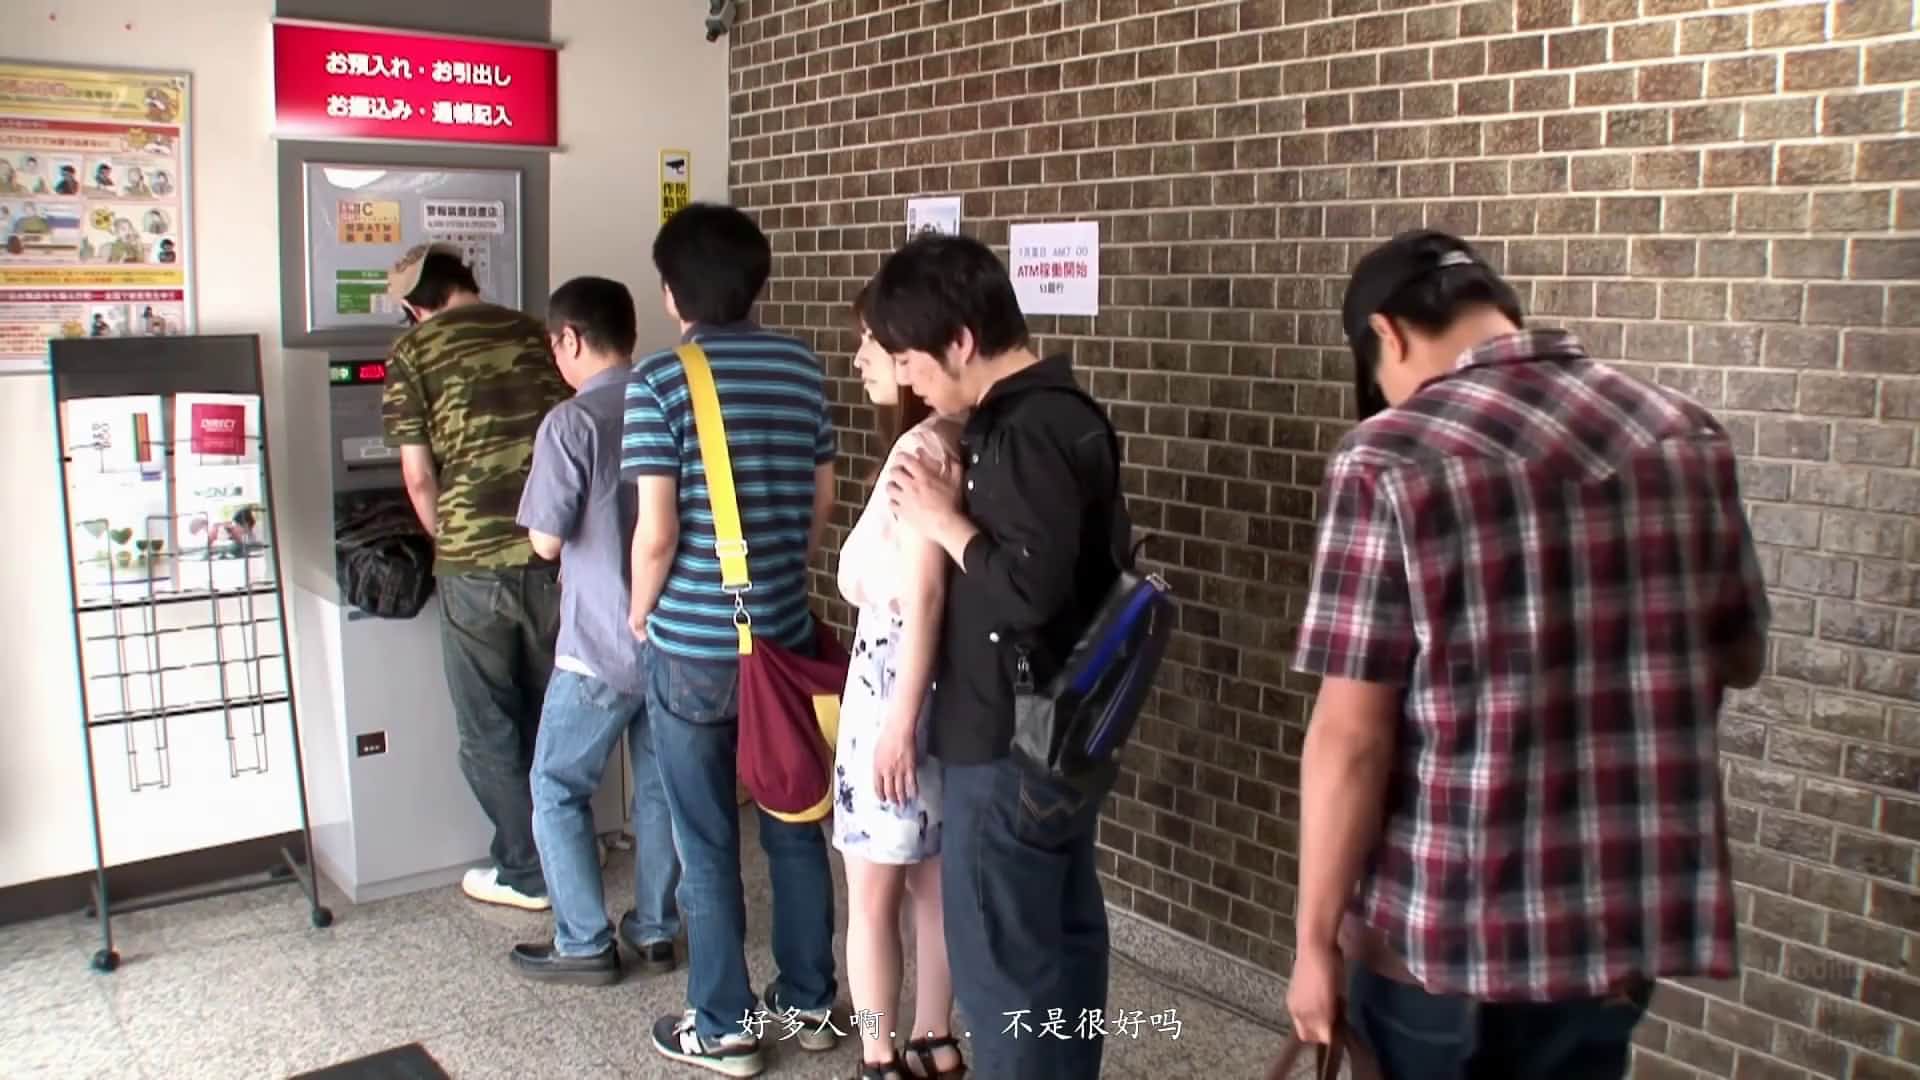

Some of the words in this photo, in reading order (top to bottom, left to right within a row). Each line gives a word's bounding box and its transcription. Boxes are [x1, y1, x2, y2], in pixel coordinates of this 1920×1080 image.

[325, 51, 512, 86] お預入れ・お引出し
[326, 95, 513, 127] お振込み・通帳記入
